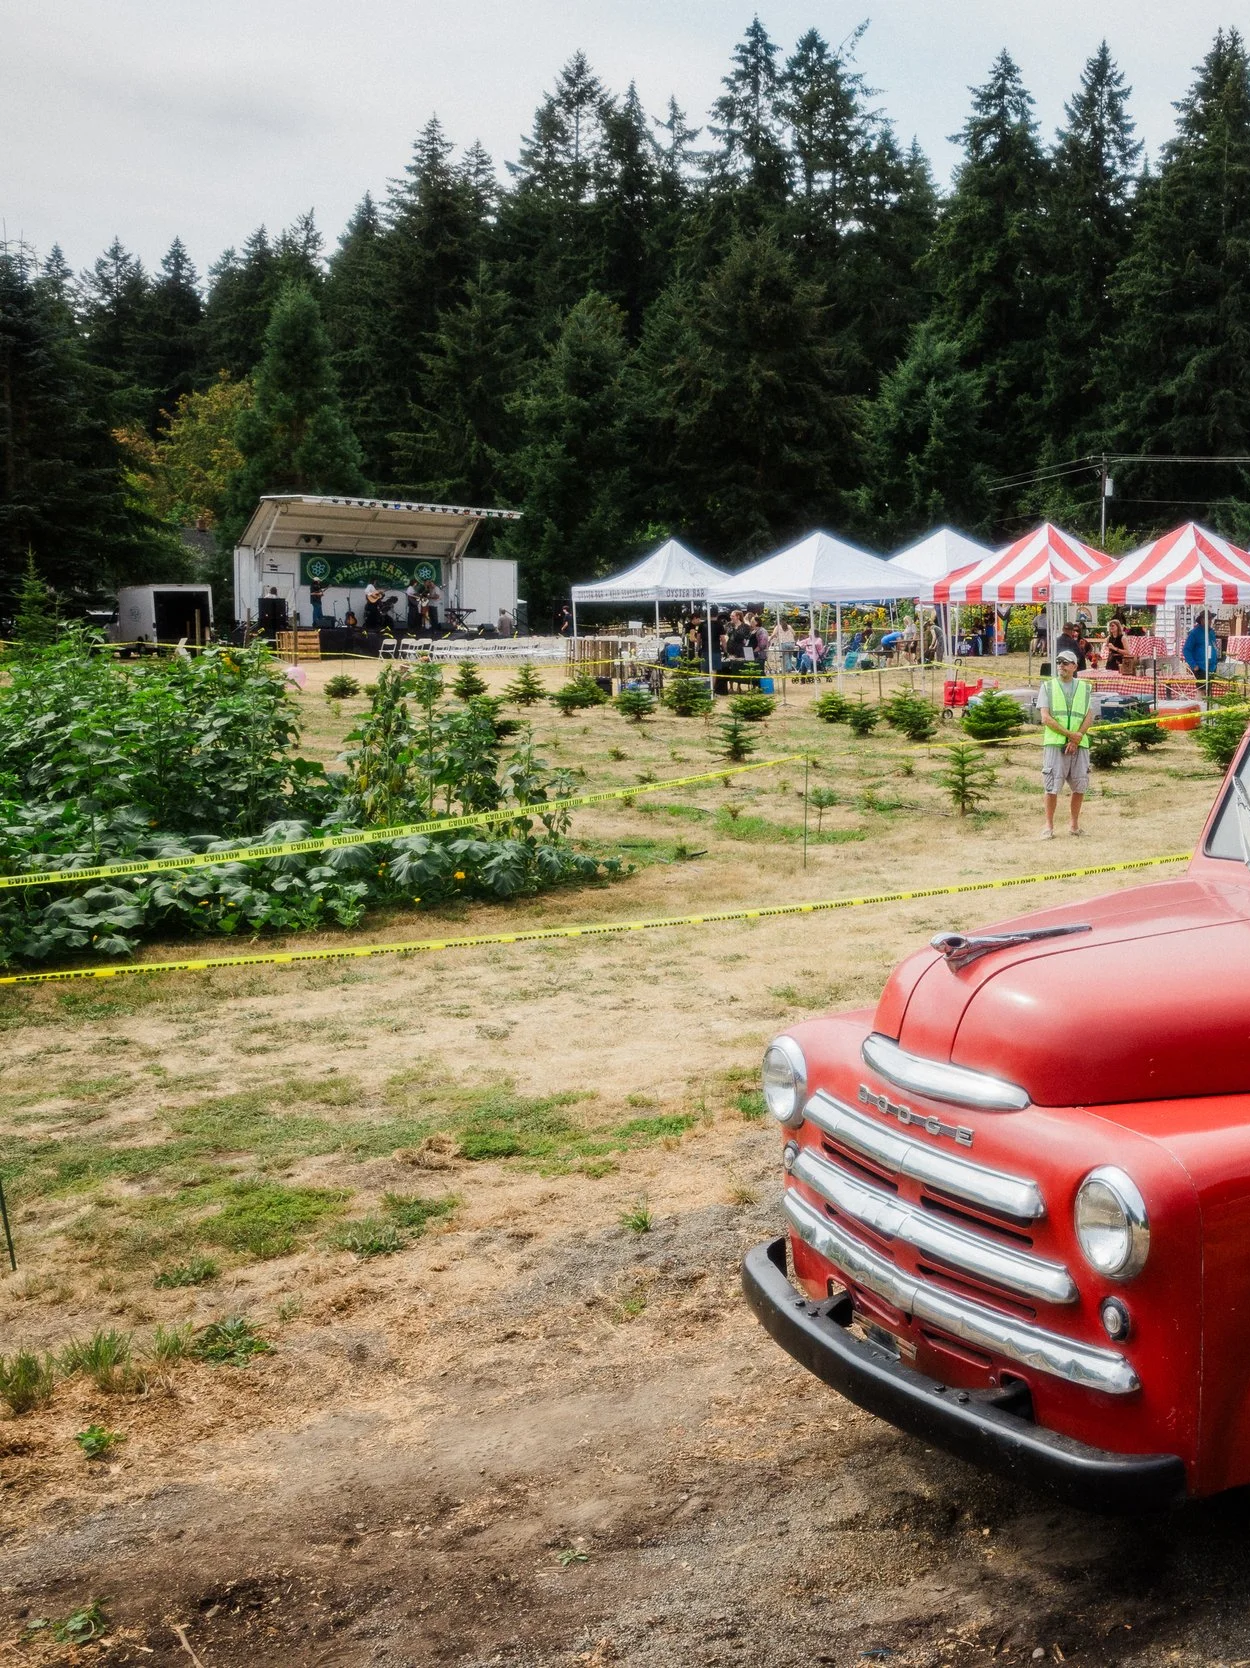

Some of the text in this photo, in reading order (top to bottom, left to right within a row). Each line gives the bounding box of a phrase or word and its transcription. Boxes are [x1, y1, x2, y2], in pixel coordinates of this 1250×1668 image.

[335, 560, 377, 584] DAHLIA
[666, 588, 705, 598] OYSTER BAR
[858, 1083, 974, 1148] DODGE
